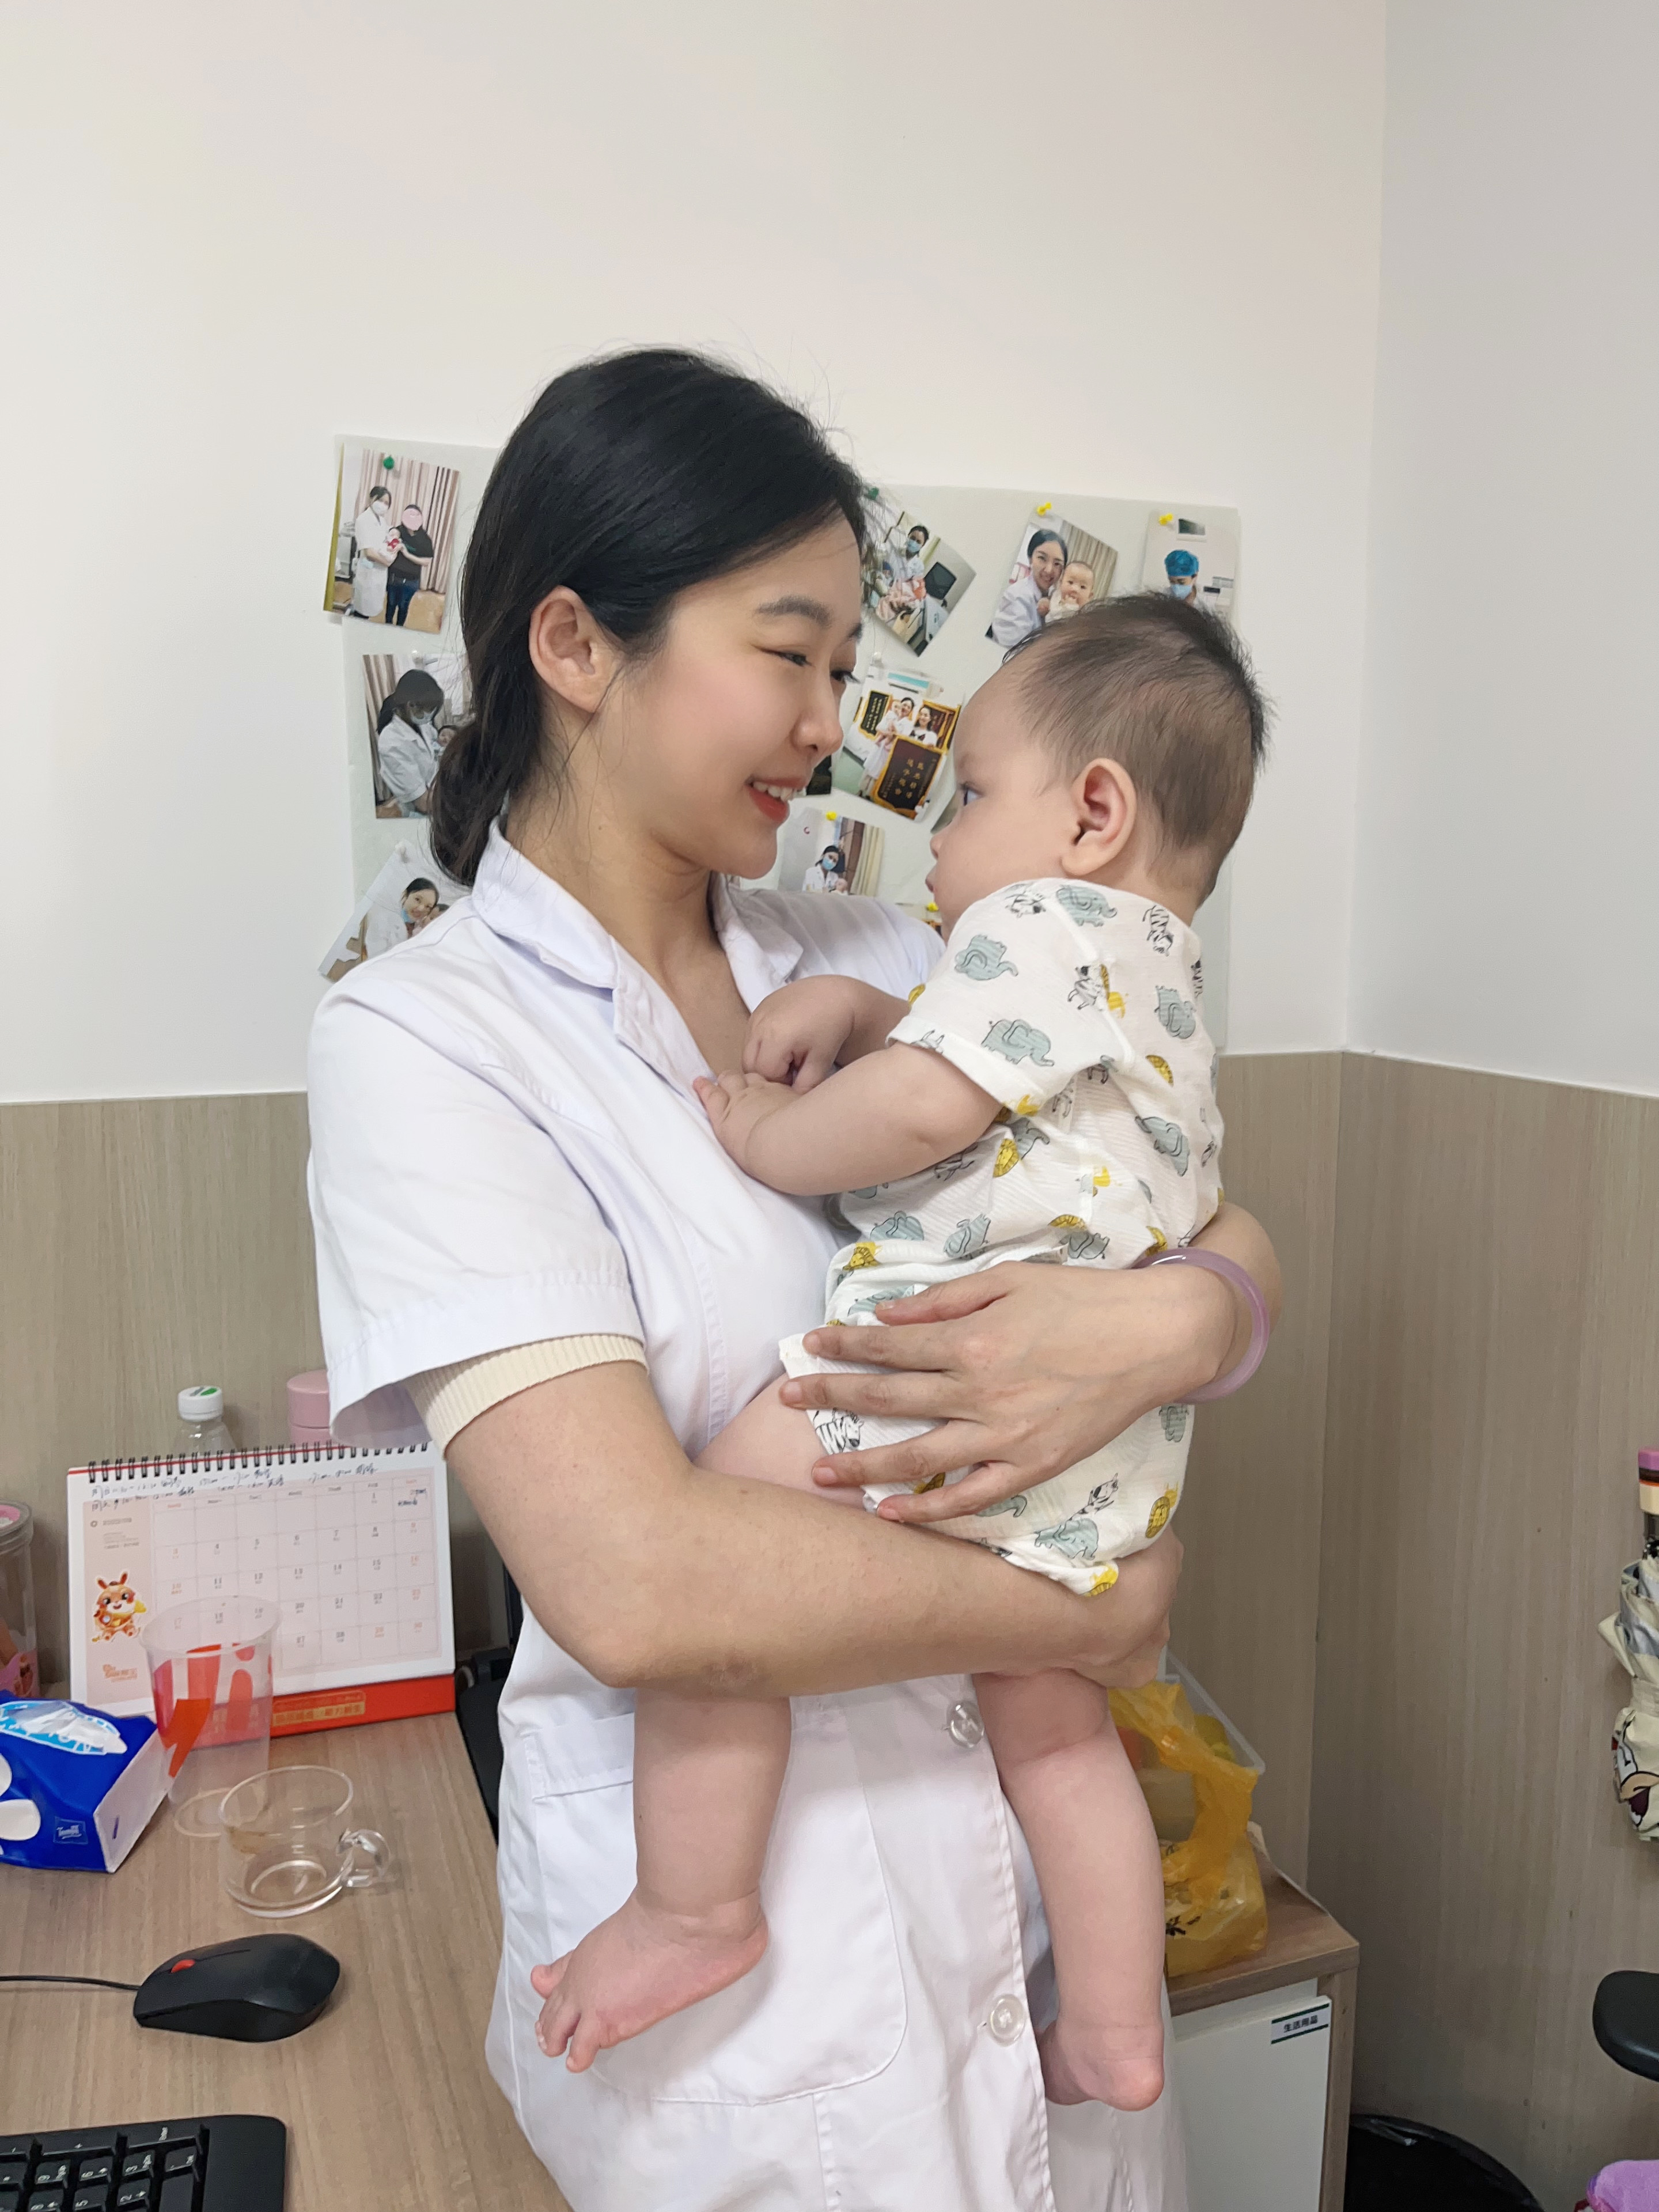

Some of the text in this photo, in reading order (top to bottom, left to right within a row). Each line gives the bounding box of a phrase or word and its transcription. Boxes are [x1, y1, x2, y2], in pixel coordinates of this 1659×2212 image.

[1283, 2015, 1318, 2033] 生活用品
[120, 2194, 132, 2202] 2
